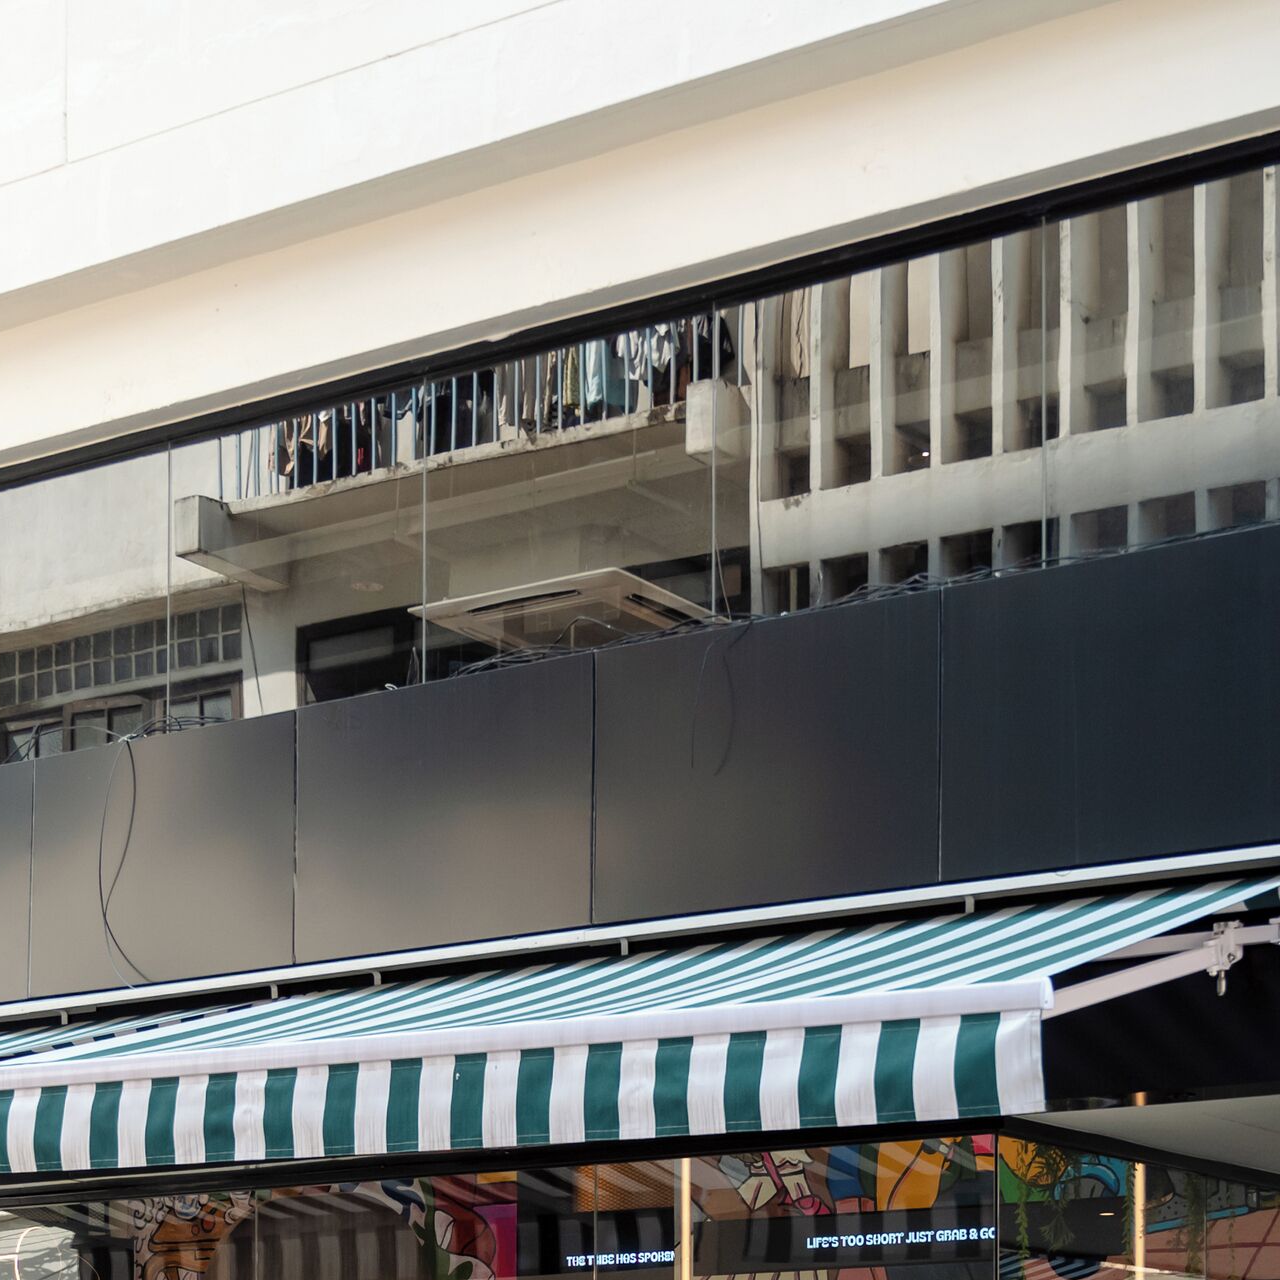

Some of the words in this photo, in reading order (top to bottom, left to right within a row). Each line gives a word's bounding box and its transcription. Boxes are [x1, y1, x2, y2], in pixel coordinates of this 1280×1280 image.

[840, 1234, 864, 1247] TOO
[865, 1232, 905, 1246] SHORT
[906, 1230, 934, 1244] JUST
[936, 1228, 967, 1242] GRAB
[969, 1227, 978, 1240] &
[566, 1255, 586, 1267] THE
[587, 1253, 615, 1266] TIBE
[616, 1252, 637, 1264] HAS
